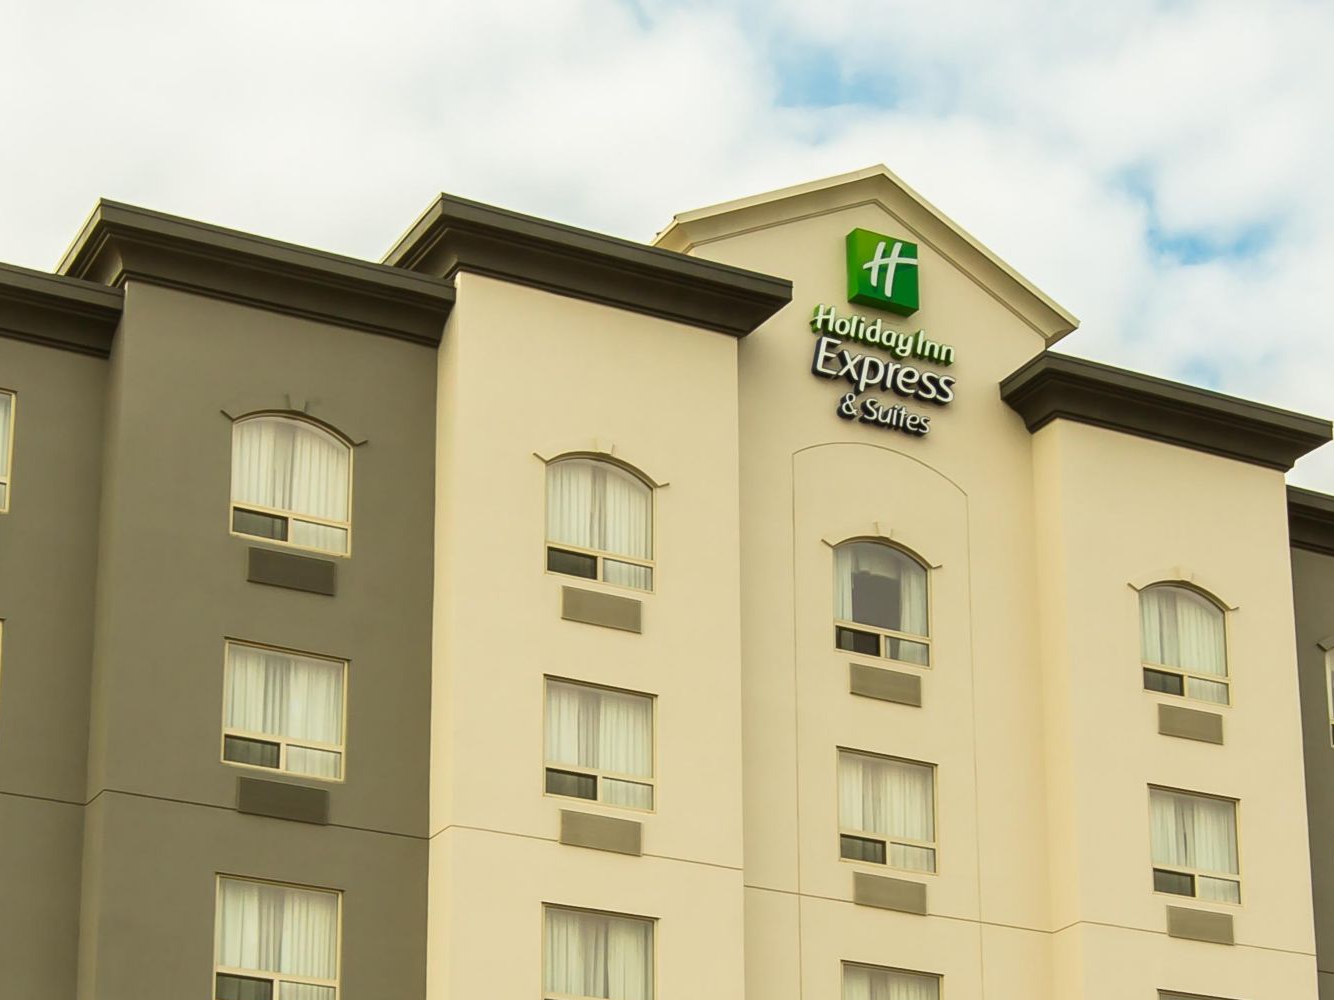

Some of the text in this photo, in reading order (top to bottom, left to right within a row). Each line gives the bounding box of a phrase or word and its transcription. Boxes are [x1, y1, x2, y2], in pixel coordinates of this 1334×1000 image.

[810, 304, 955, 364] Holiday Inn
[814, 336, 956, 403] Express
[840, 393, 931, 434] & Suites
